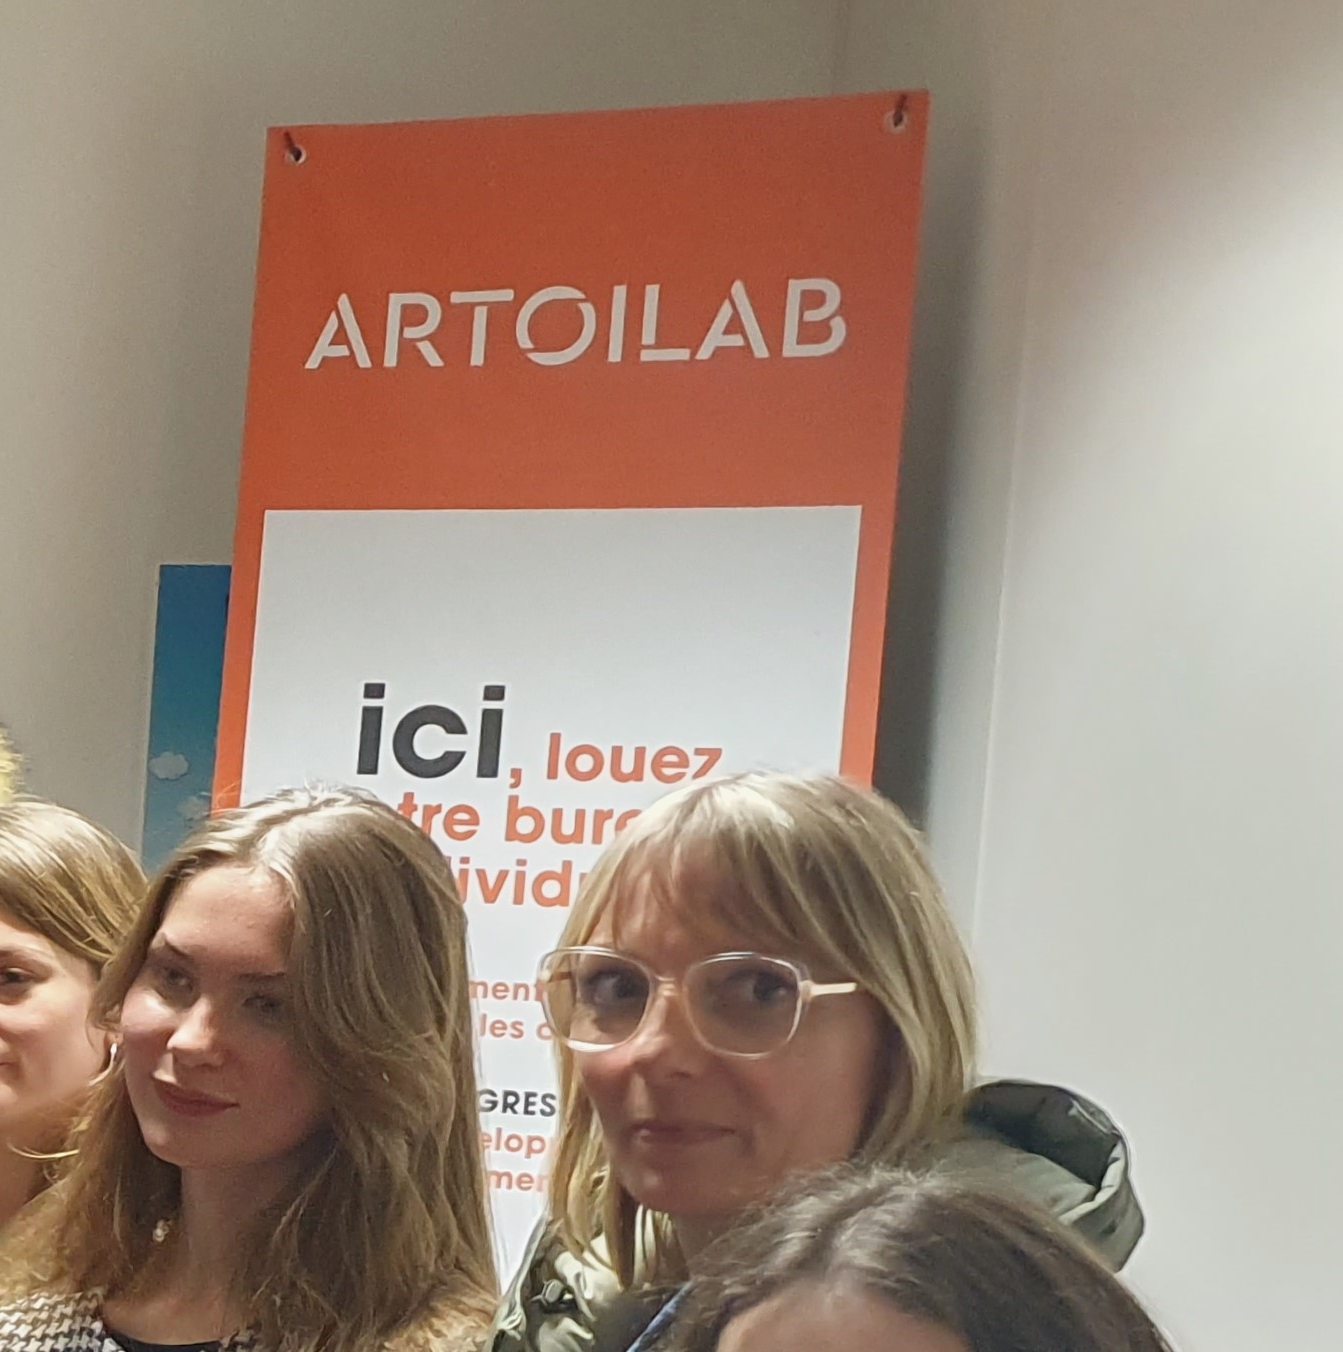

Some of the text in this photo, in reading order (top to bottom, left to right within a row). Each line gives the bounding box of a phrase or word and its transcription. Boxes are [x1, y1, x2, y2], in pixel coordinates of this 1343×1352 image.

[304, 278, 848, 370] ARTOILAB
[356, 682, 723, 789] ici, louez
[445, 856, 586, 907] ivid
